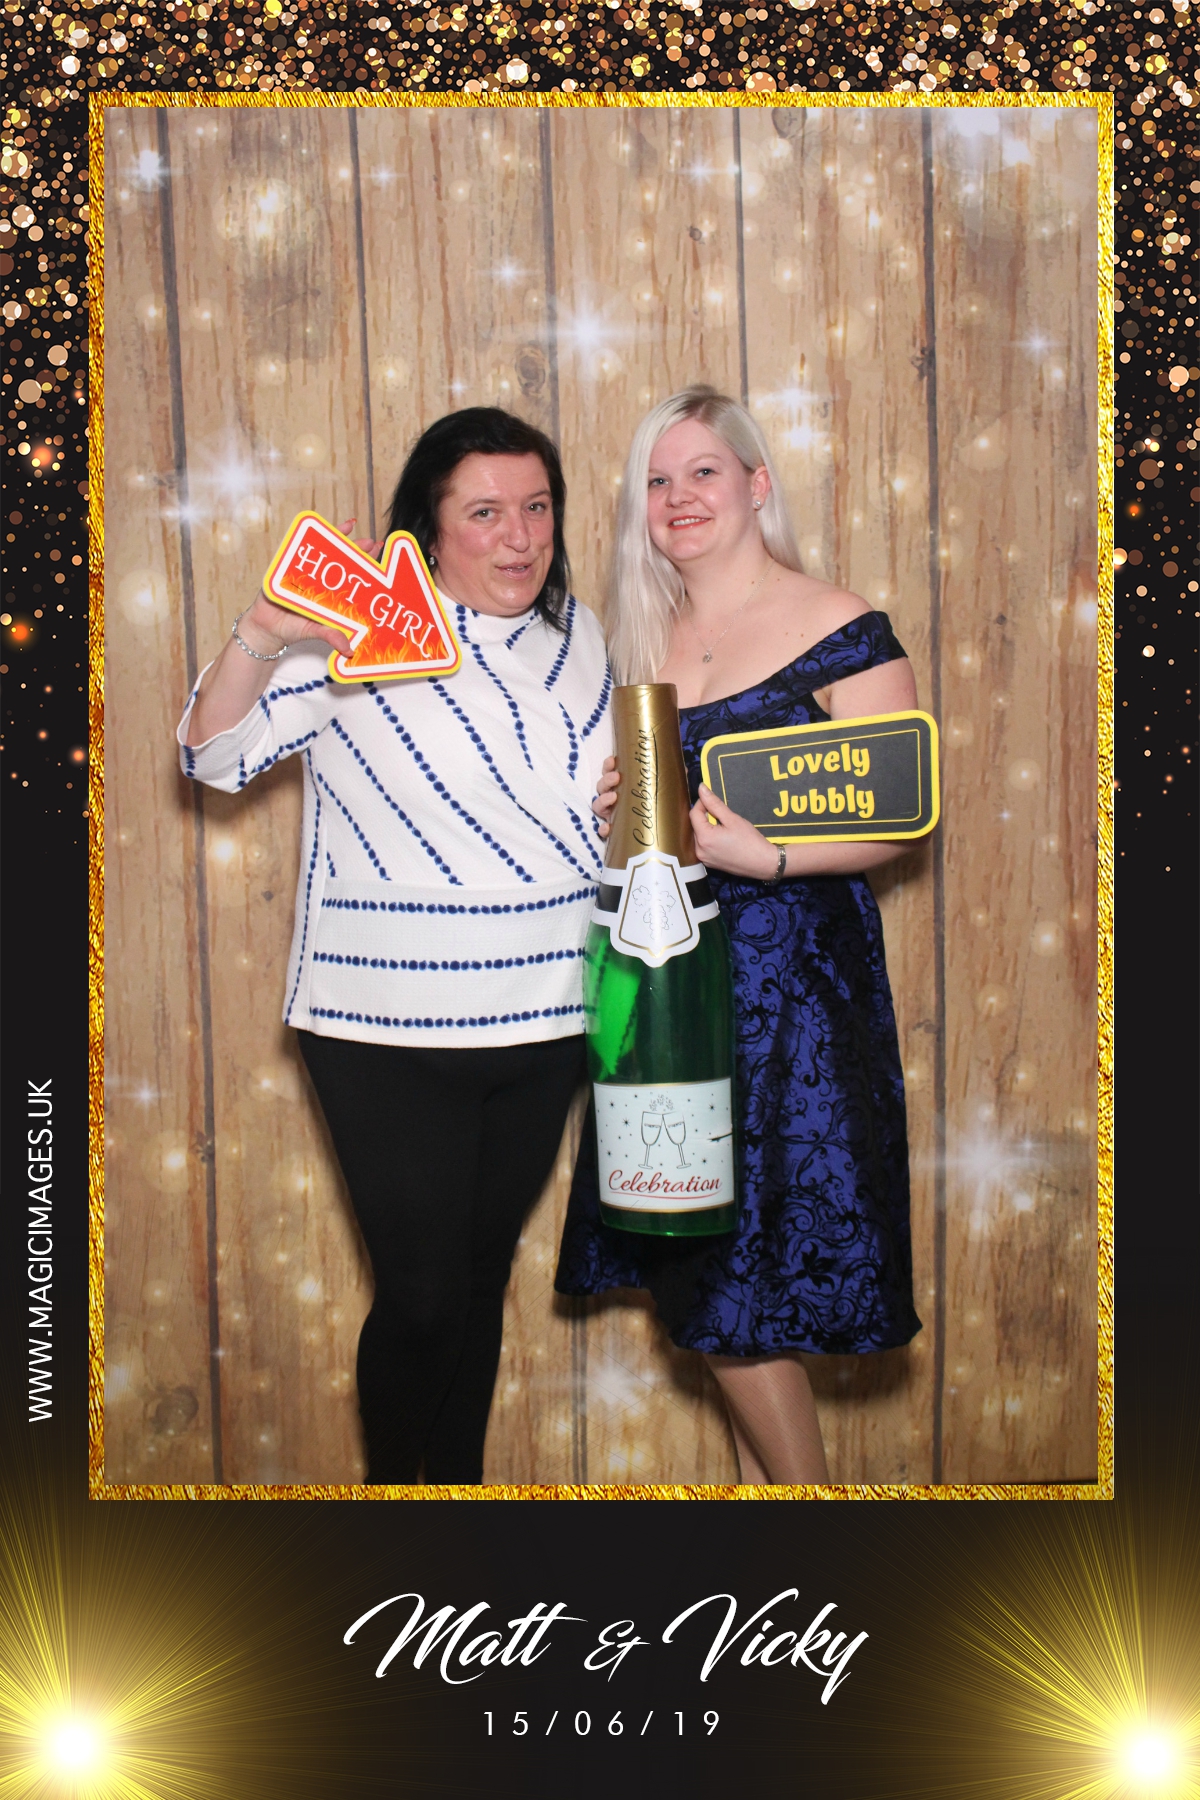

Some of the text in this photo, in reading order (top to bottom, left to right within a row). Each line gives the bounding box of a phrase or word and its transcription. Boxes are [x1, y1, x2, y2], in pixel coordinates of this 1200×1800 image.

[295, 543, 435, 659] HOT GIRL
[769, 743, 871, 781] Lovely
[631, 727, 658, 847] Celebration
[772, 784, 875, 819] Jubbly
[608, 1169, 723, 1194] Celebration
